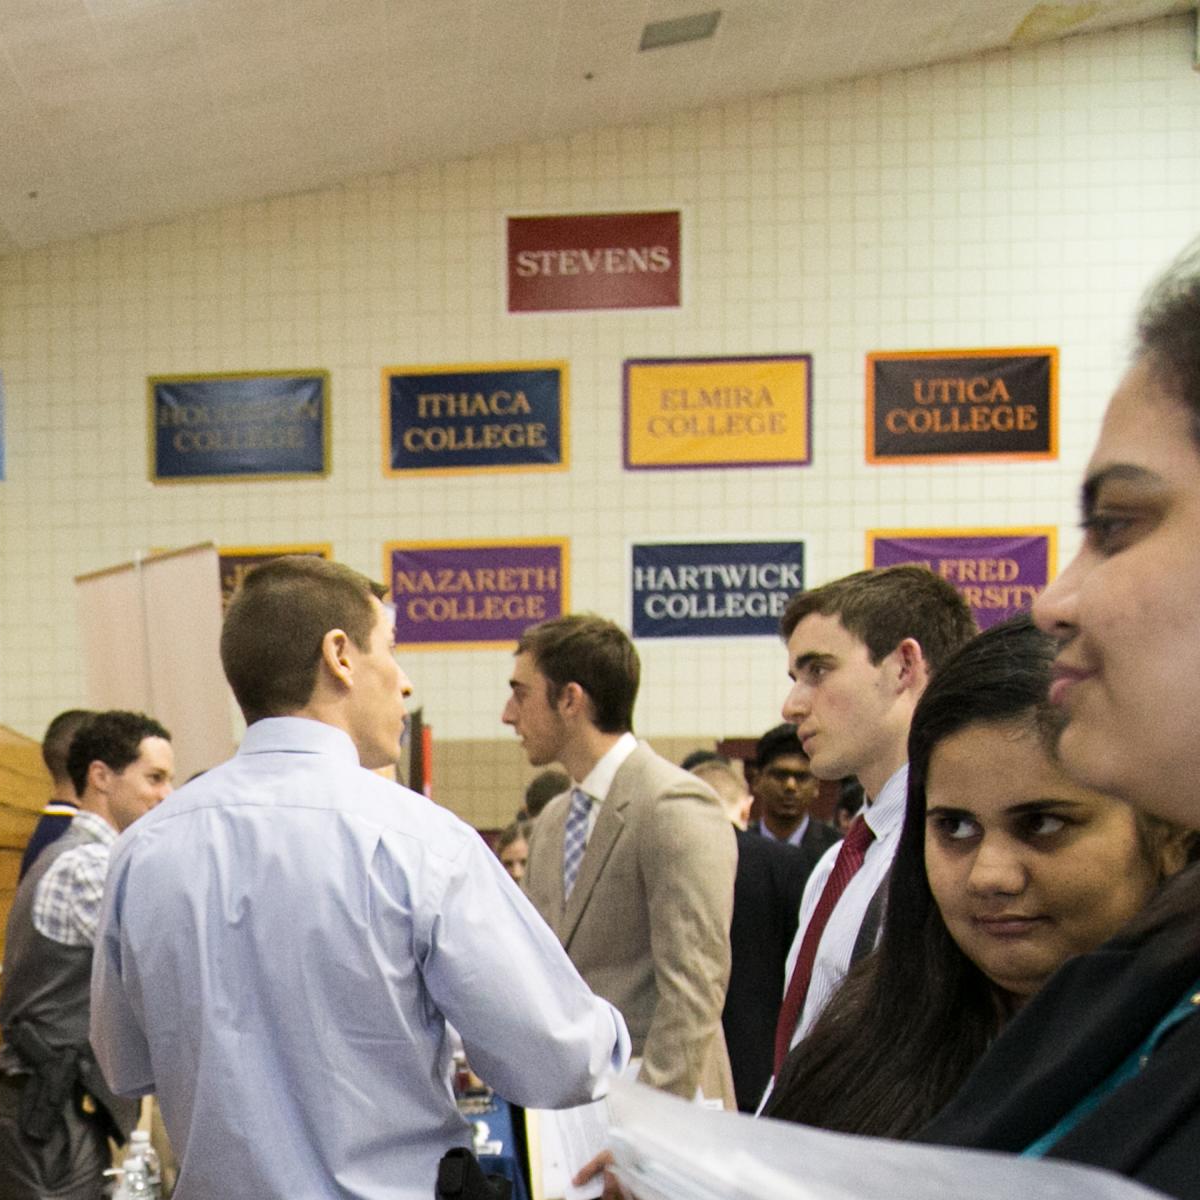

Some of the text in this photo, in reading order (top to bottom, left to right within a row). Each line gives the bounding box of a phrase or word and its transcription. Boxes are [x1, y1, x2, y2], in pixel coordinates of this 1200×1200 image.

[516, 246, 672, 277] STEVENS
[417, 391, 532, 418] ITHACA
[660, 386, 774, 410] ELMIRA
[913, 378, 1010, 405] UTICA
[647, 413, 786, 438] COLLEGE
[886, 405, 1038, 433] COLLEGE
[403, 423, 547, 453] COLLEGE
[396, 567, 558, 594] NAZARETH
[634, 563, 801, 590] HARTWICK
[407, 595, 546, 622] COLLEGE
[645, 592, 789, 618] COLLEGE
